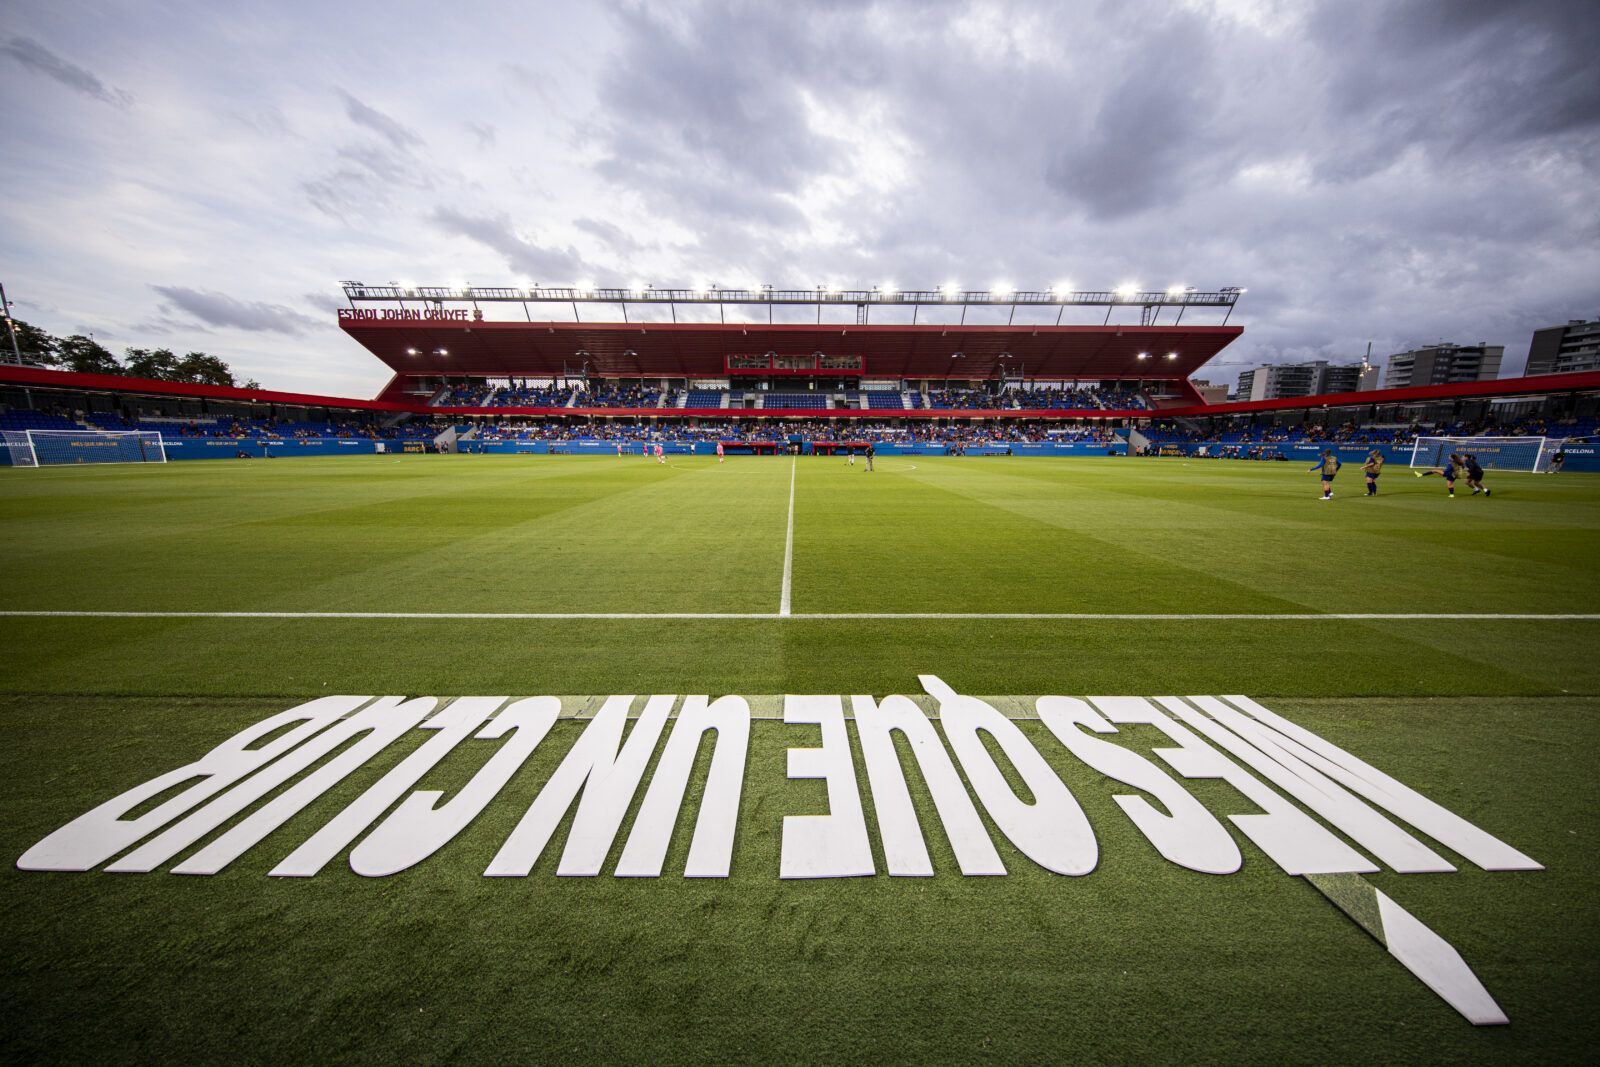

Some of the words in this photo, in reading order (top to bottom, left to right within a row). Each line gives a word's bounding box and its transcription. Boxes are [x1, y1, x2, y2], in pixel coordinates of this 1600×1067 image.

[337, 308, 378, 320] ESTADI
[380, 308, 421, 320] JOHAN
[423, 309, 469, 320] CRUYFF
[16, 695, 562, 878] CLUB
[483, 694, 751, 878] UN
[780, 674, 1099, 878] QUE
